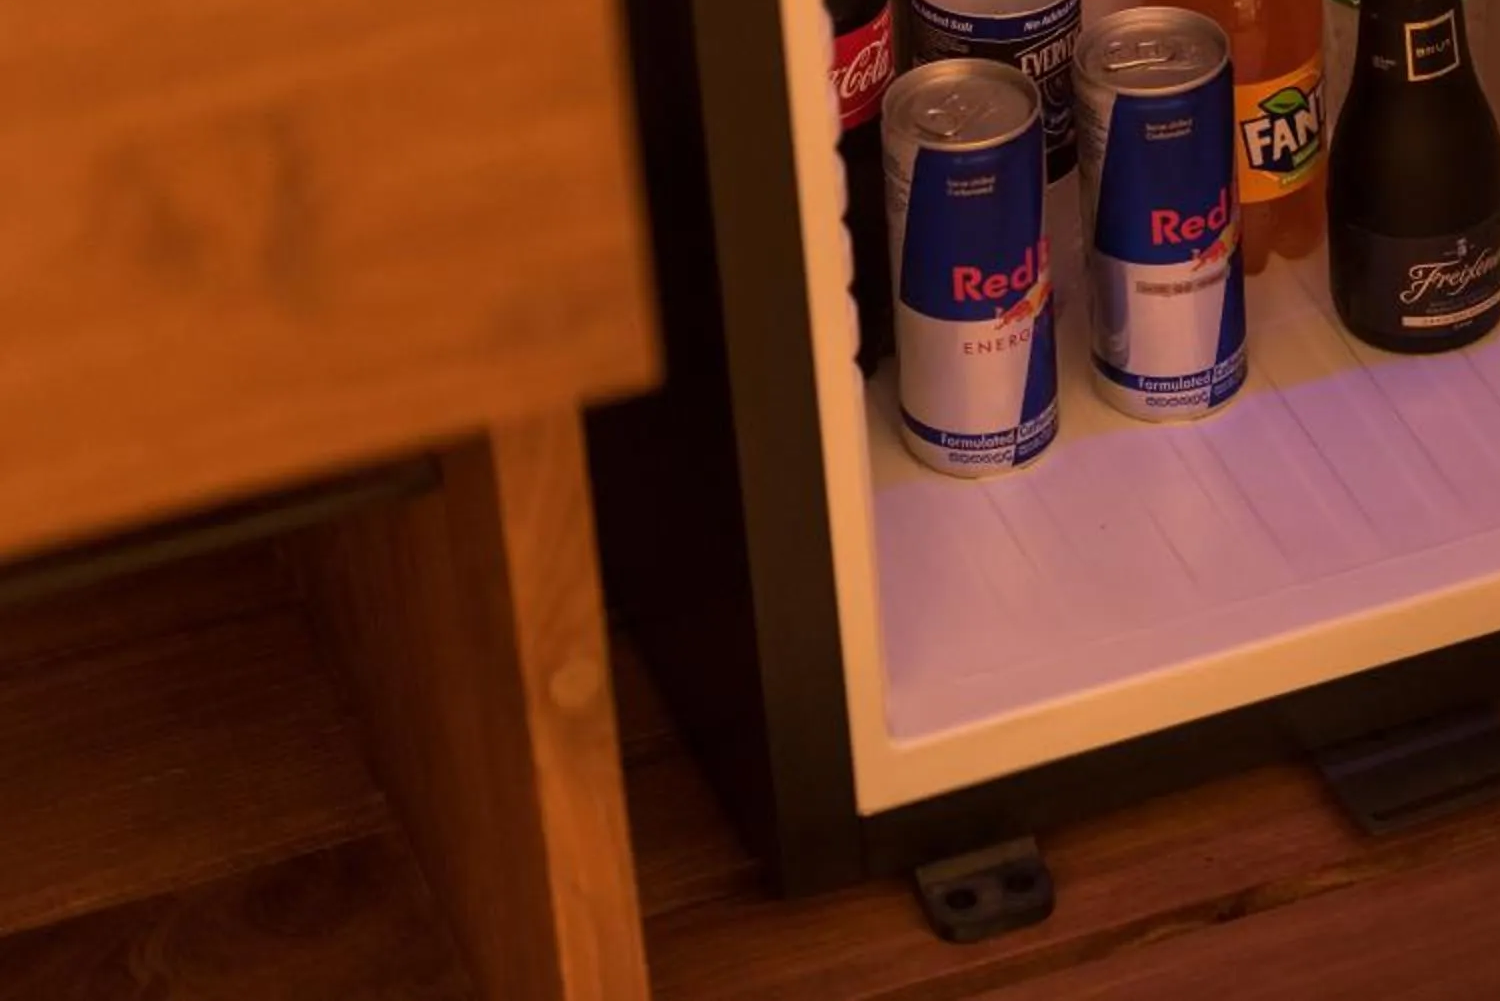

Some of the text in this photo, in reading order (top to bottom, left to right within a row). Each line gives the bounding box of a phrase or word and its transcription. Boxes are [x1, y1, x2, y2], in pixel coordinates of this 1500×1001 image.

[1243, 90, 1321, 167] FAN
[1151, 186, 1228, 246] Red
[952, 247, 1034, 302] Red
[1138, 370, 1213, 392] Formulated
[939, 431, 1016, 450] Formulated
